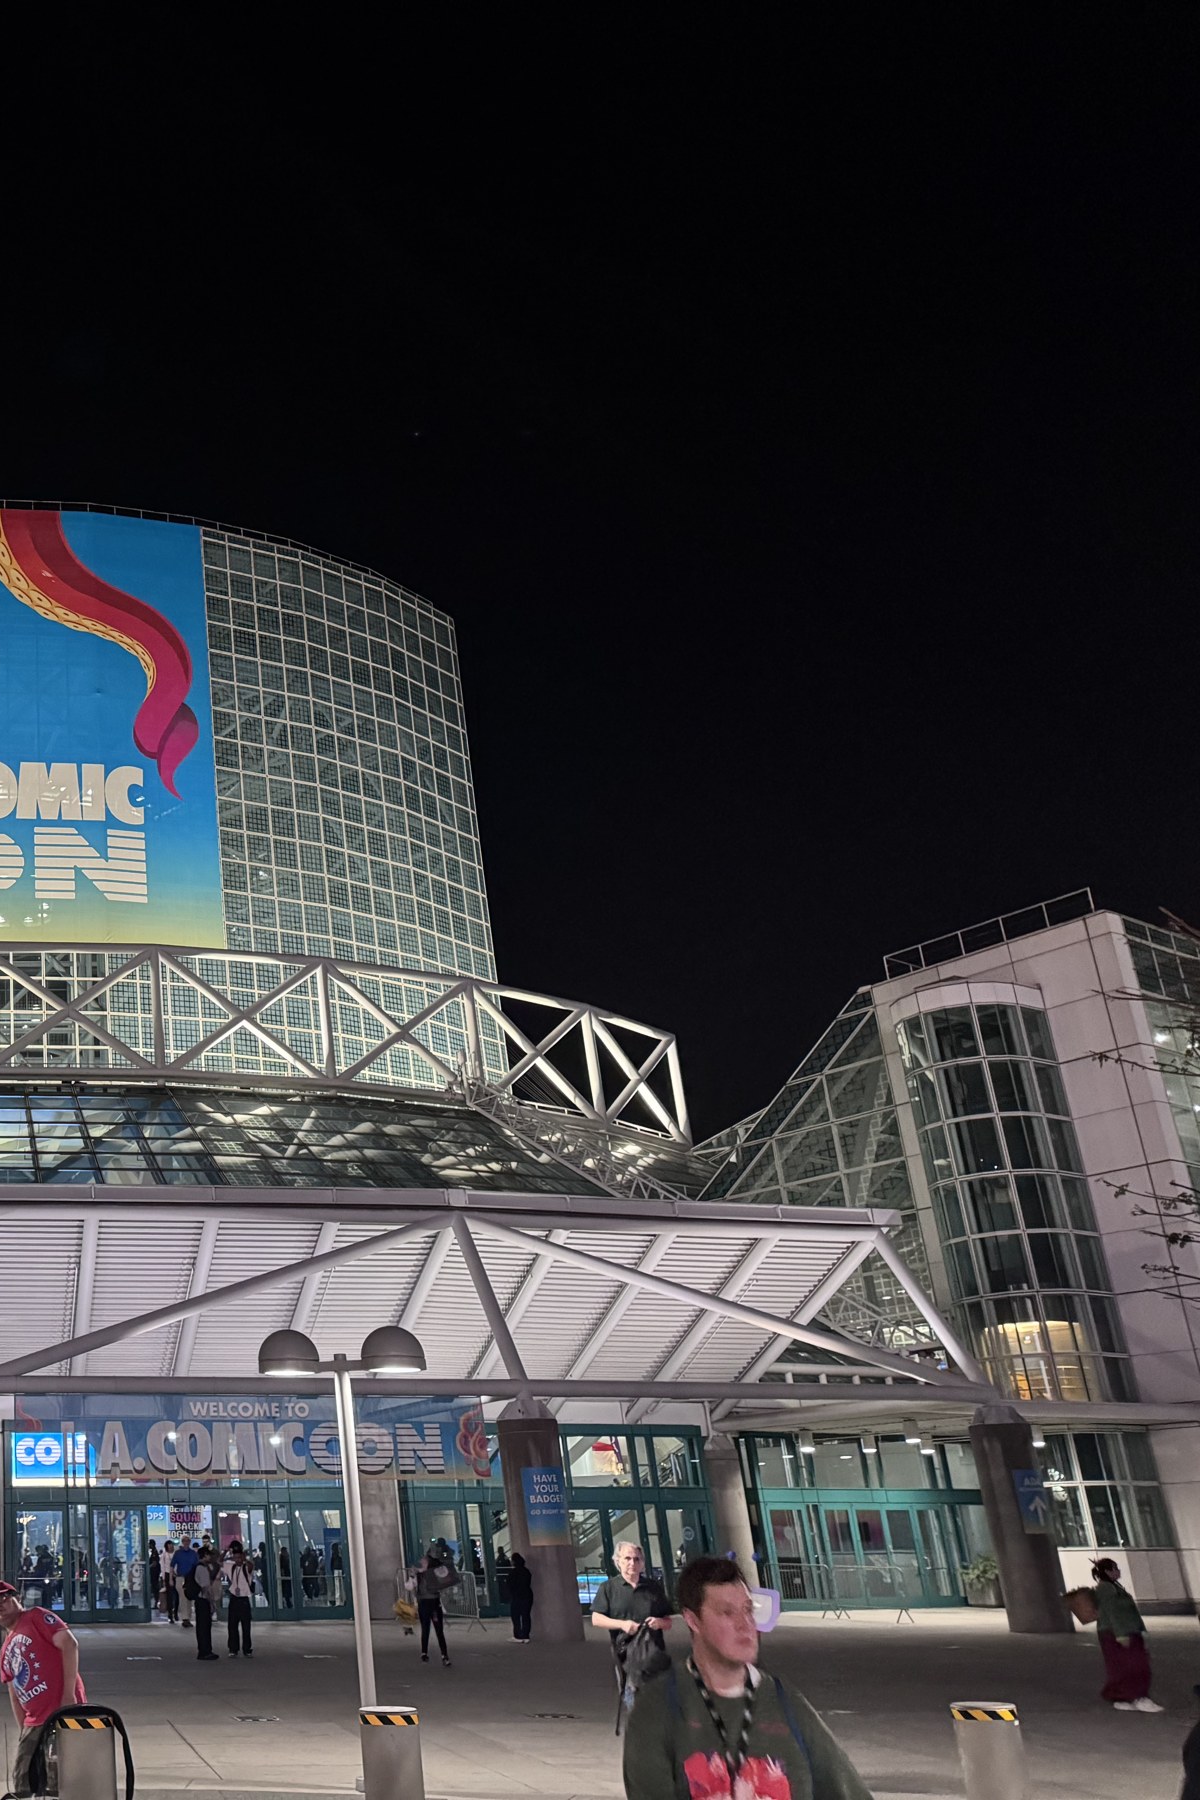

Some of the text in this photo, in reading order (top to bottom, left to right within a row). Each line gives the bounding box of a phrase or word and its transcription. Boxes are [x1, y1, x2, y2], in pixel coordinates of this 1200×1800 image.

[190, 1401, 309, 1418] WELCOME TO
[148, 1421, 304, 1475] COMIC
[308, 1422, 445, 1475] CON
[533, 1474, 557, 1483] HAVE
[534, 1484, 559, 1493] YOUR
